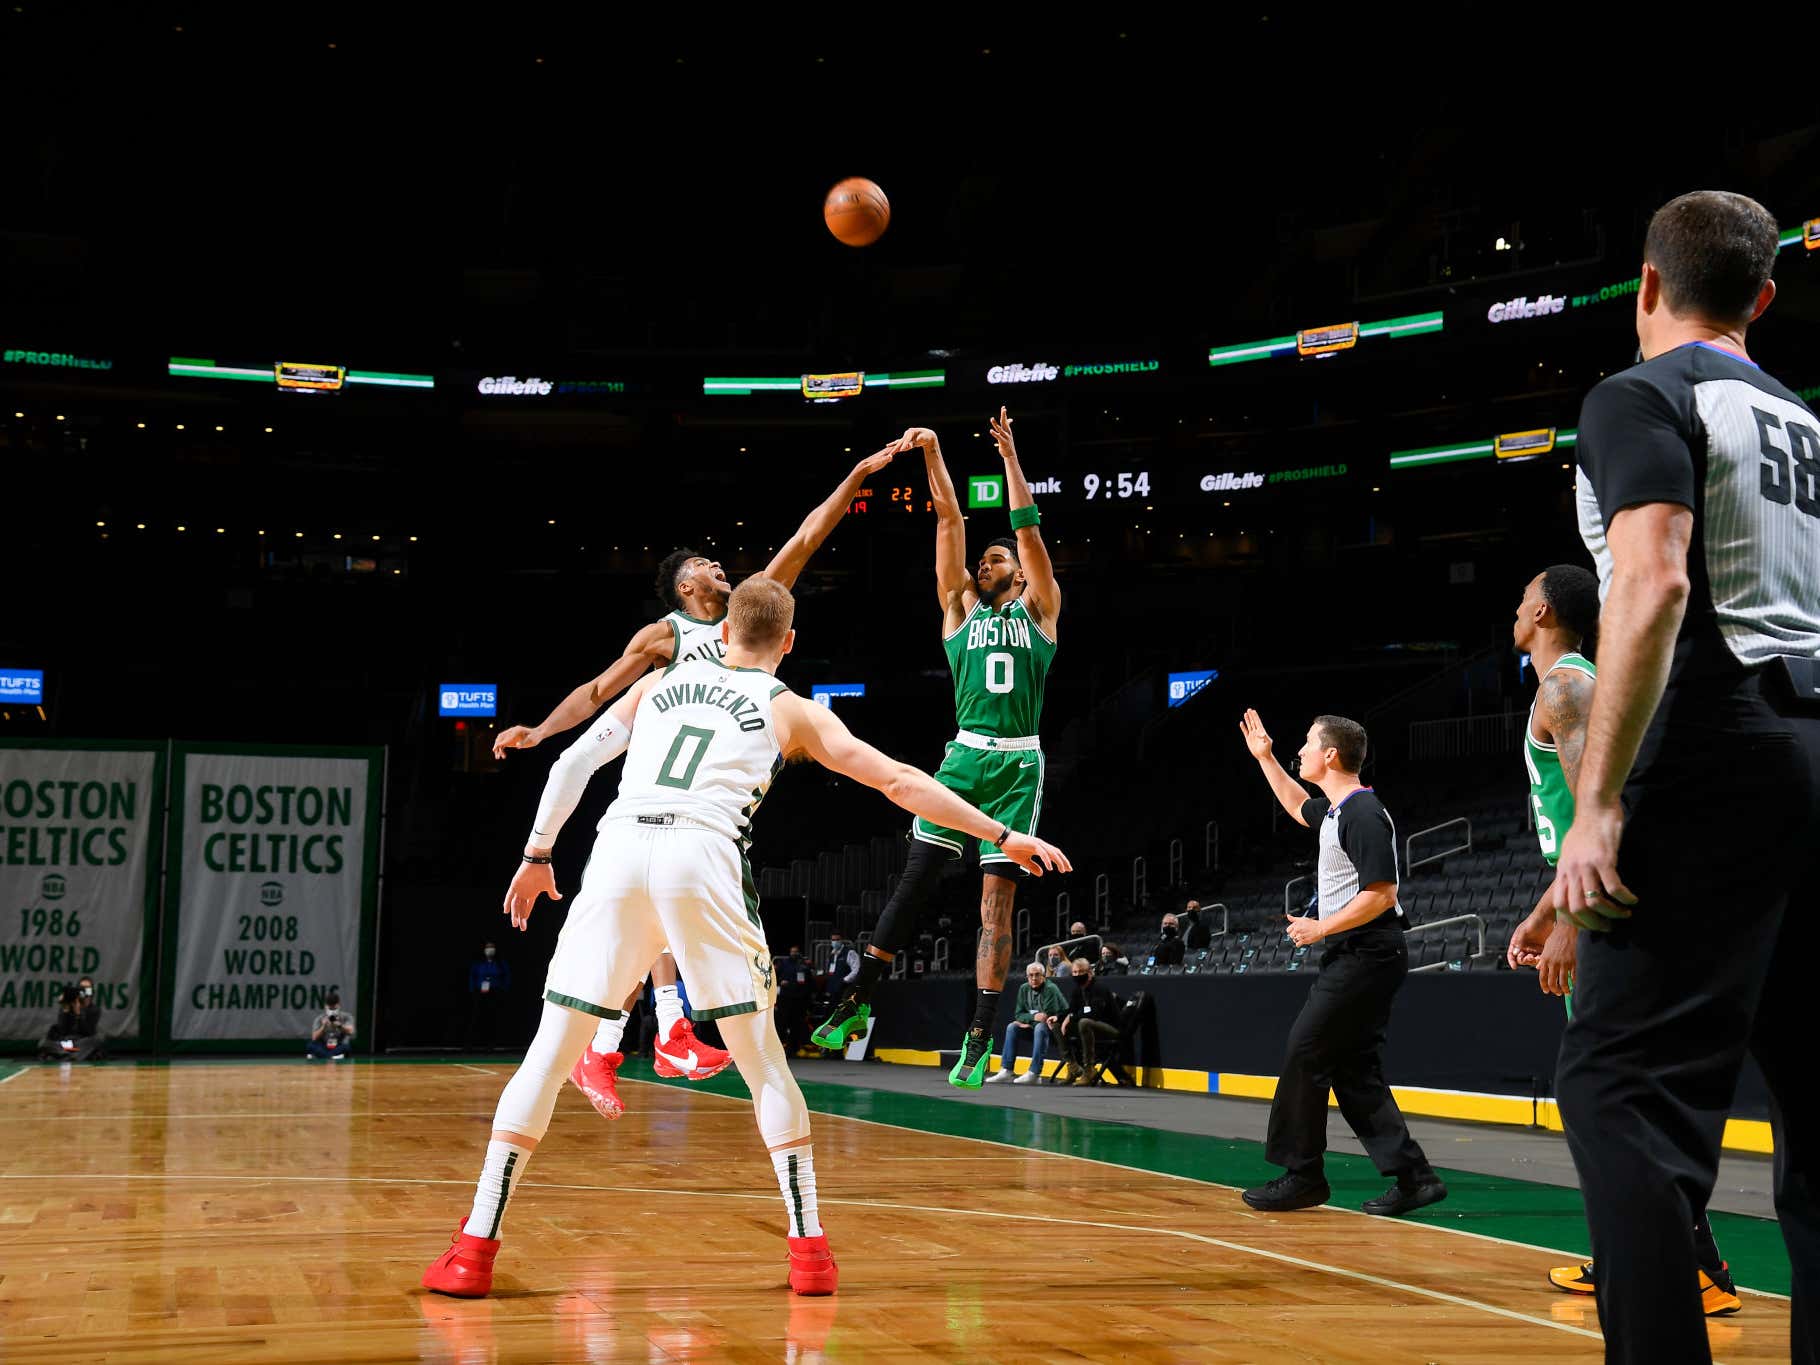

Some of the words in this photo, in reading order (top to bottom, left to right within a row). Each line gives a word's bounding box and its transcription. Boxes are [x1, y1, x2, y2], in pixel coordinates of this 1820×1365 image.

[1488, 294, 1567, 323] Gillette
[478, 376, 553, 395] Gillette
[987, 363, 1060, 384] Gillette
[1751, 405, 1820, 519] 58
[972, 481, 999, 502] TD
[1028, 477, 1062, 494] ank
[1083, 471, 1150, 500] 9:54
[1200, 472, 1265, 491] Gillette
[1269, 464, 1347, 483] #PROSHIELD
[967, 617, 1032, 650] BOSTON
[0, 677, 40, 689] TUFTS
[986, 653, 1014, 694] 0
[459, 692, 495, 702] TUFTS
[652, 683, 765, 733] DIVINCENZO
[655, 724, 715, 791] 0
[0, 780, 137, 820] OSTON
[200, 784, 352, 826] BOSTON
[0, 826, 127, 867] ELTICS
[203, 832, 344, 874] CELTICS
[20, 908, 81, 937] 1986
[238, 915, 298, 941] 2008
[1, 944, 100, 974] WORLD
[224, 950, 315, 976] WORLD
